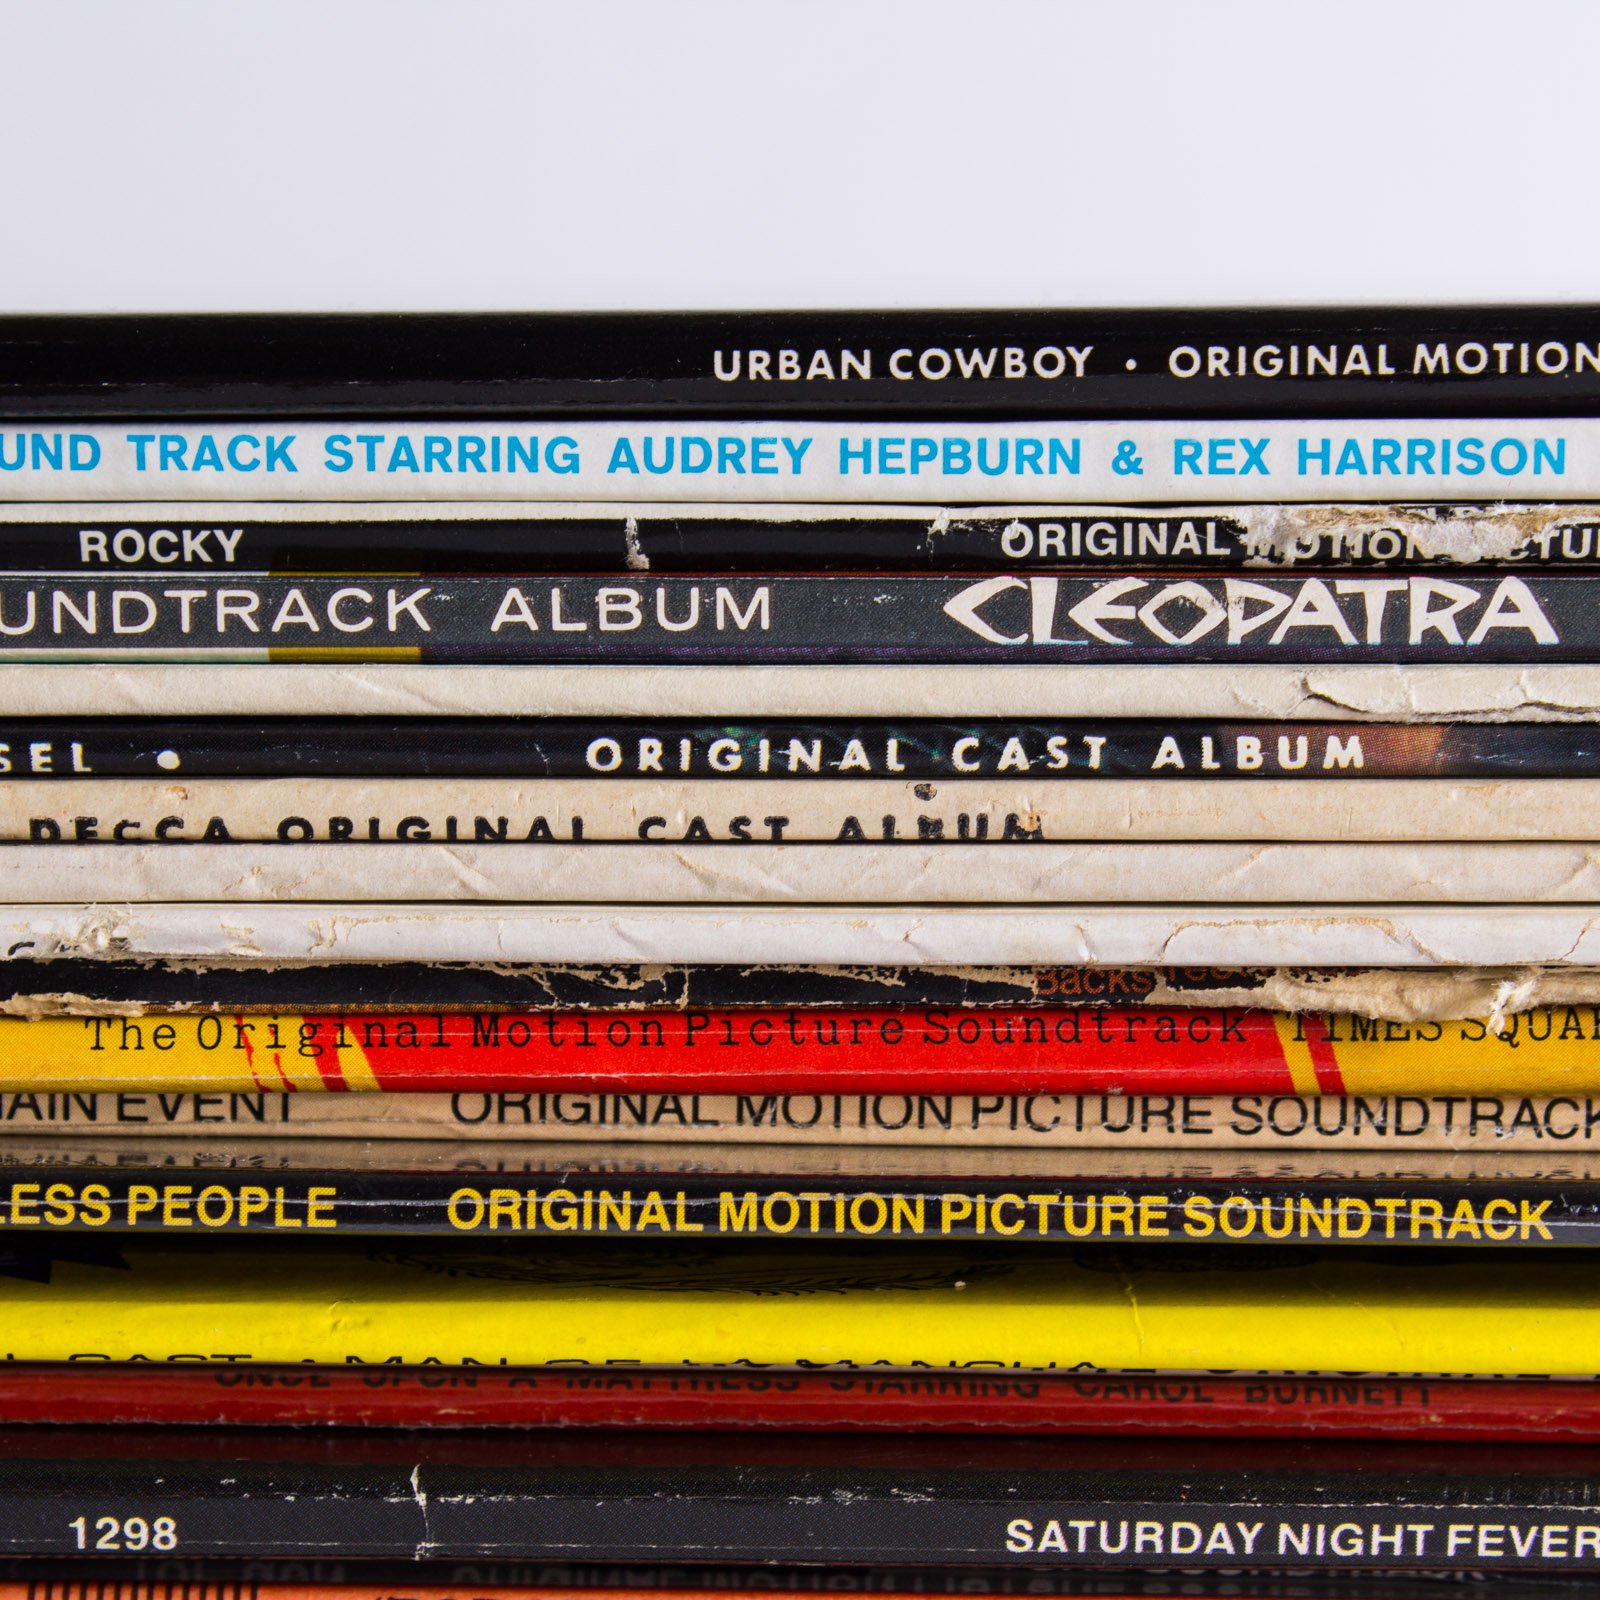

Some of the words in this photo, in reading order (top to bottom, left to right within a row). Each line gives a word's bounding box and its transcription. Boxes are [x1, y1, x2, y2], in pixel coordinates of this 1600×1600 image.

[713, 349, 871, 382] URBAN
[889, 346, 1094, 381] COWBOY
[1168, 344, 1395, 378] ORIGINAL
[1413, 341, 1600, 375] MOTION
[0, 432, 102, 472] UND
[125, 433, 299, 473] TRACK
[323, 433, 581, 475] STARRING
[607, 435, 814, 476] AUDREY
[839, 436, 1081, 477] HEPBURN
[1111, 439, 1145, 476] &
[1173, 437, 1272, 476] REX
[1297, 437, 1566, 477] HARRISON
[79, 528, 243, 563] ROCKY
[999, 522, 1231, 560] ORIGINAL
[0, 587, 432, 636] UNDTRACK
[490, 586, 770, 632] ALBUM
[940, 576, 1562, 648] CLEOPATRA
[585, 737, 905, 773] ORIGINAL
[951, 735, 1107, 772] CAST
[1150, 734, 1365, 770] ALBUM
[29, 816, 230, 840] DECCA
[277, 815, 585, 840] ORIGINAL
[638, 815, 793, 840] CAST
[84, 1013, 176, 1051] The
[196, 1014, 455, 1058] Original
[470, 1012, 665, 1049] Motion
[685, 1012, 905, 1048] Picture
[922, 1008, 1246, 1046] Soundtrack
[450, 1094, 720, 1126] ORIGINAL
[733, 1095, 956, 1130] MOTION
[966, 1096, 1214, 1134] PICTURE
[0, 1183, 112, 1227] ESS
[125, 1182, 340, 1230] PEOPLE
[446, 1184, 706, 1234] ORIGINAL
[715, 1188, 930, 1236] MOTION
[938, 1190, 1172, 1240] PICTURE
[1180, 1194, 1556, 1243] SOUNDTRACK
[68, 1516, 178, 1551] 1298
[1005, 1518, 1264, 1555] SATURDAY
[1277, 1522, 1435, 1557] NIGHT
[1446, 1524, 1600, 1559] FEVER
